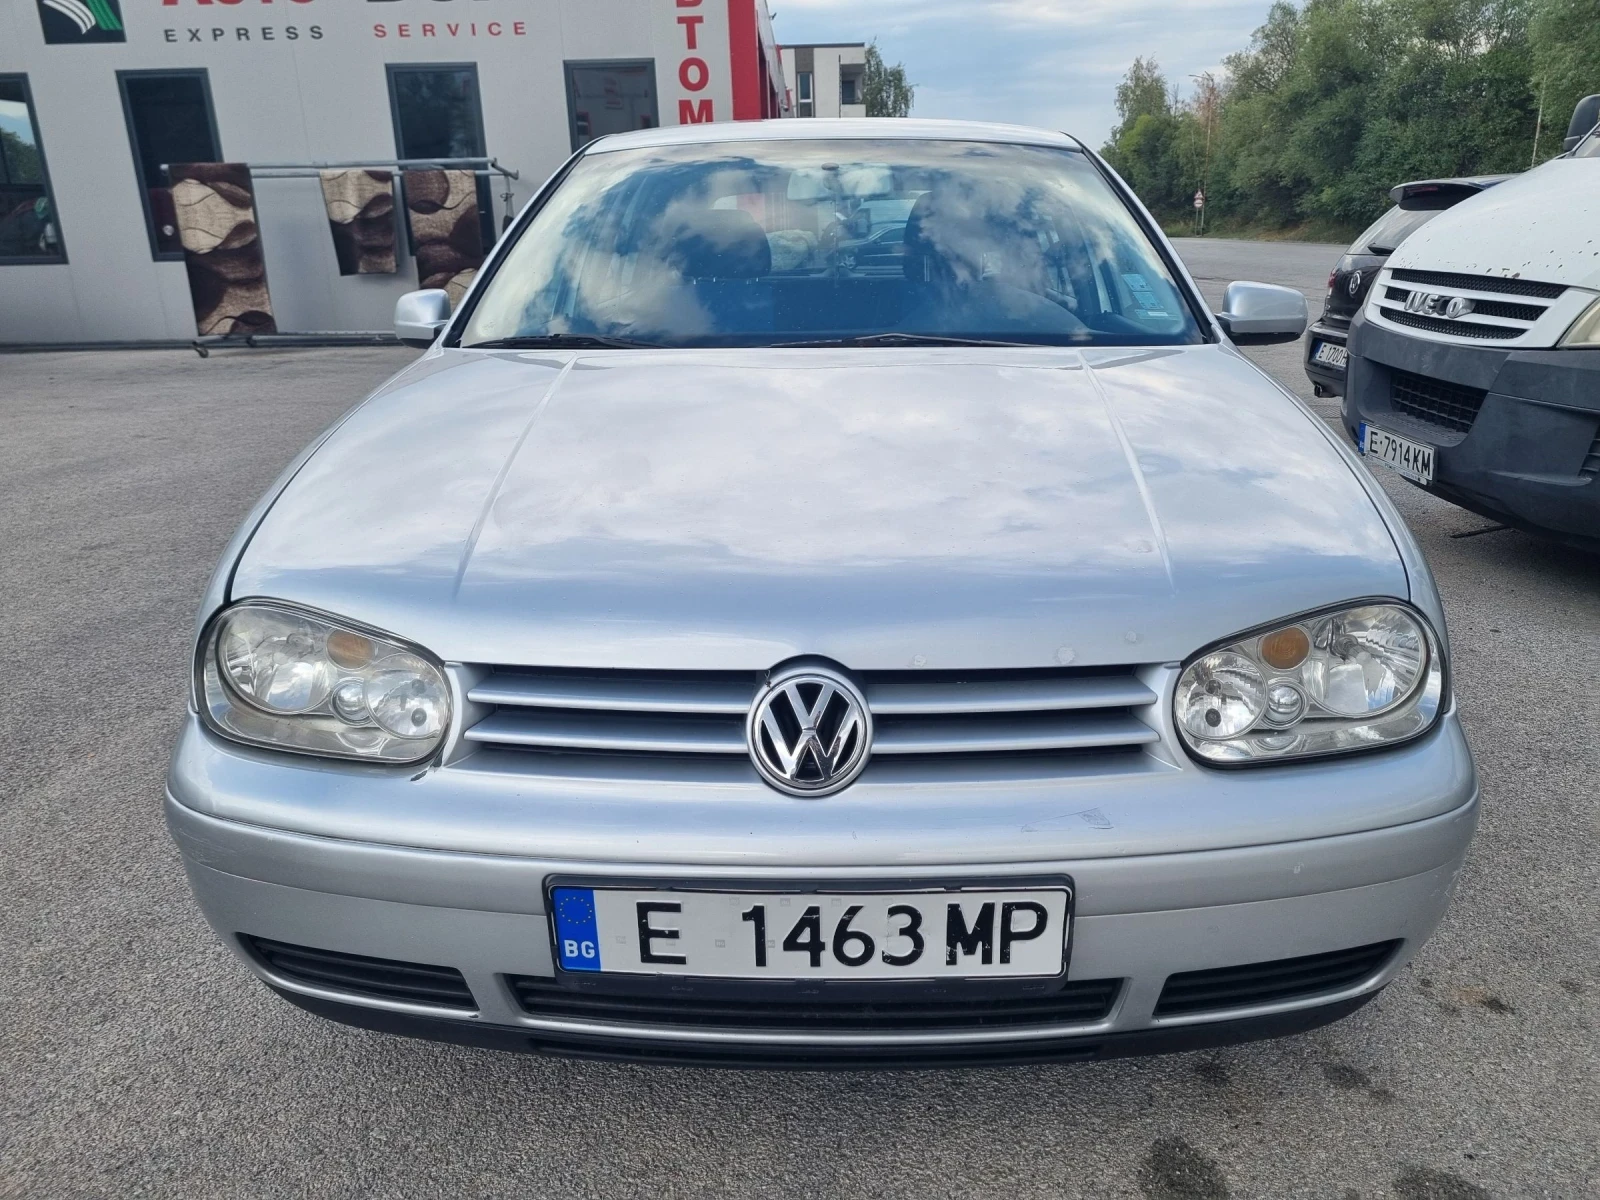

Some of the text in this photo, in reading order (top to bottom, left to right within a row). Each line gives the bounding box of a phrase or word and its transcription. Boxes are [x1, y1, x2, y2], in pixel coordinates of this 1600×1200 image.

[163, 22, 527, 43] EXPRESS SERVICE
[1404, 290, 1468, 319] IVECO
[636, 901, 1048, 967] E 1463 MP
[564, 939, 596, 959] BG
